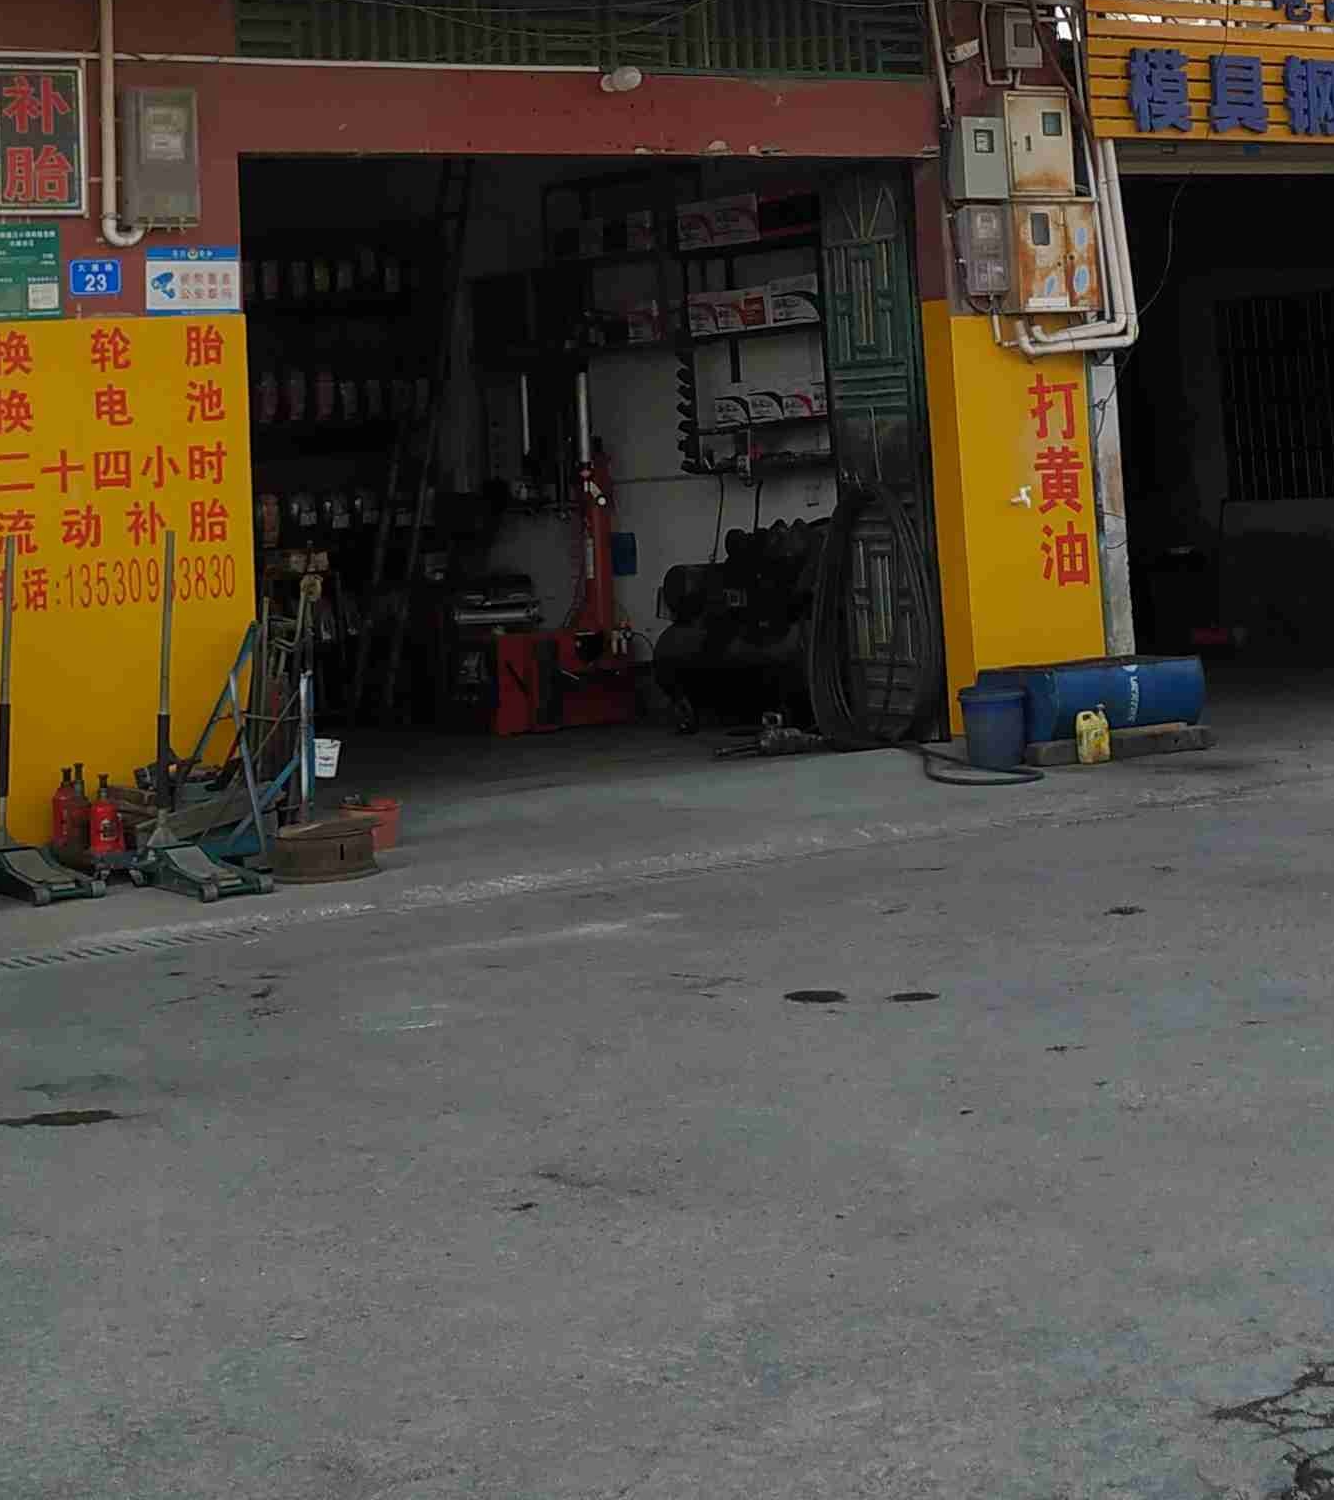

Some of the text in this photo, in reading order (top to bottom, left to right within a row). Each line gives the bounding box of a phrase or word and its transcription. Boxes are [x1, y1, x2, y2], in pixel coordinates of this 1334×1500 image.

[2, 75, 73, 203] 补胎
[84, 273, 108, 292] 23
[1027, 372, 1091, 588] 打黄油
